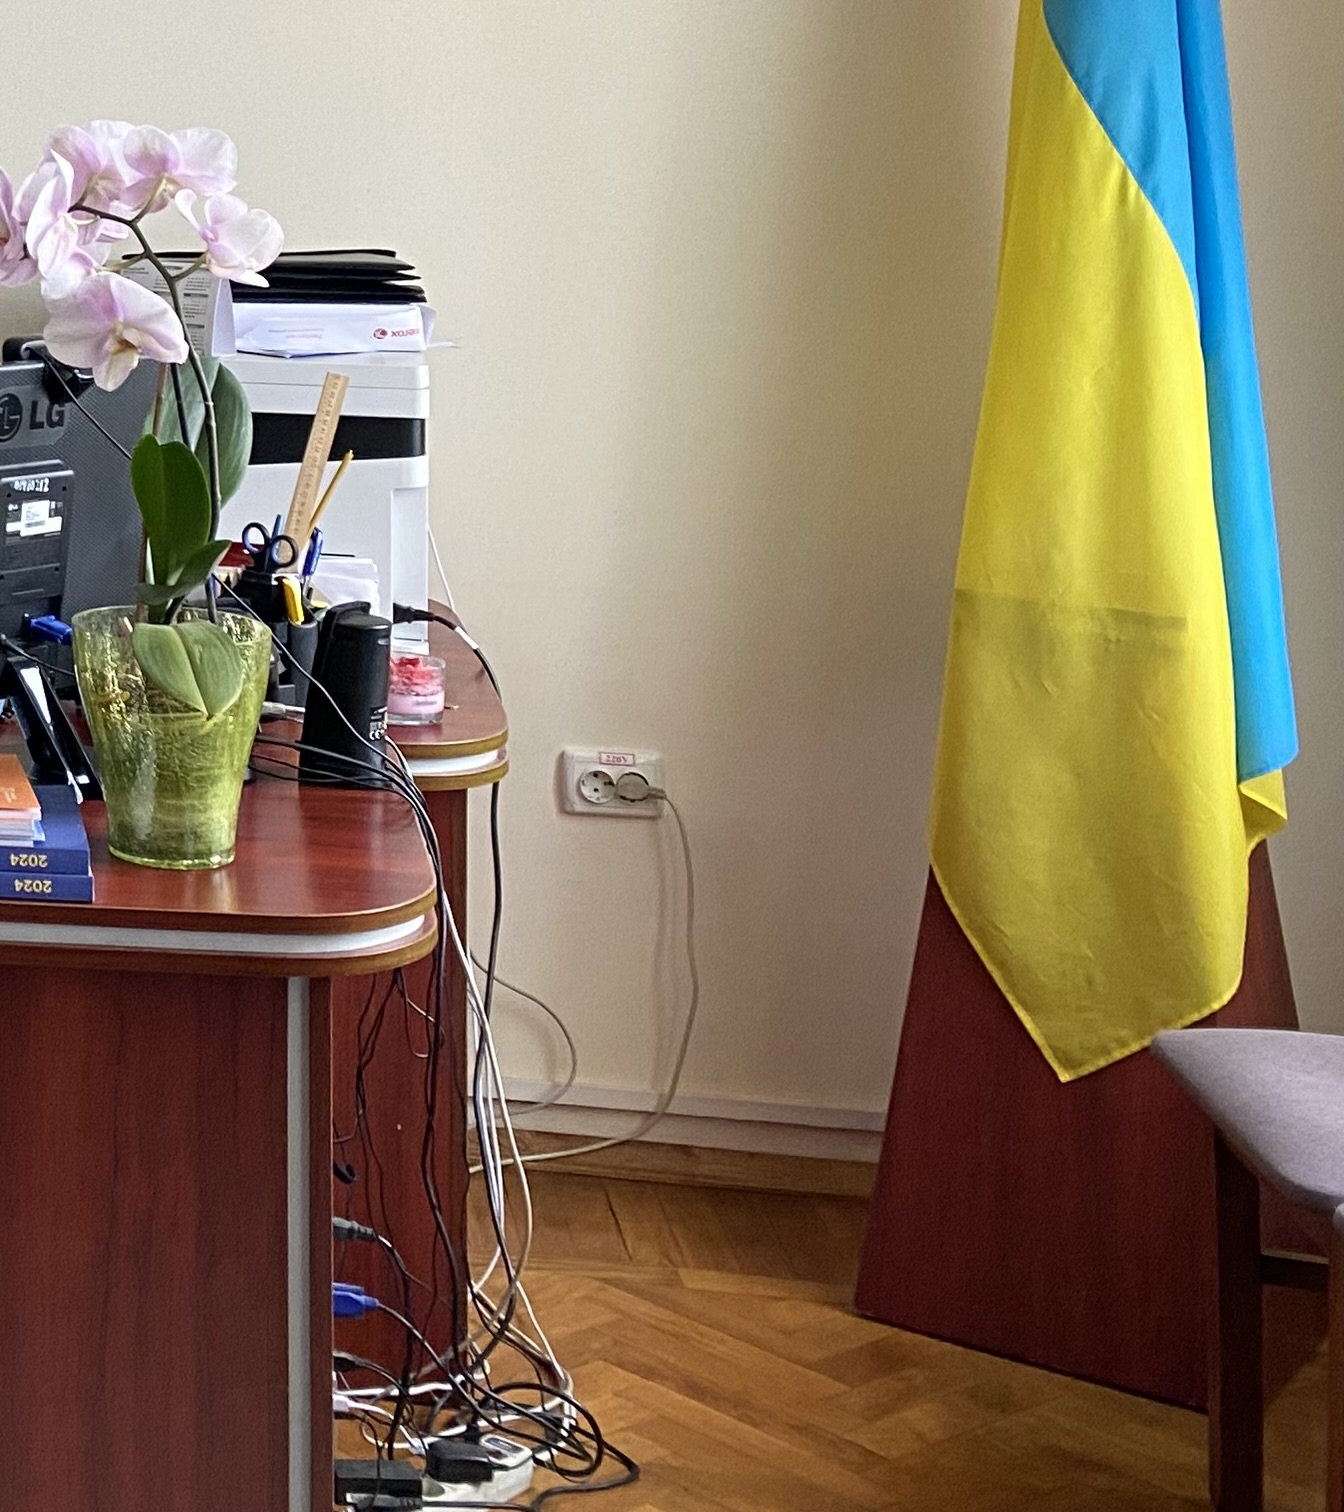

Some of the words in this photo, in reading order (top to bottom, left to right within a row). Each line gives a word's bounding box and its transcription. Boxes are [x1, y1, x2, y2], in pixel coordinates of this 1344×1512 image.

[29, 400, 65, 430] LG
[10, 852, 48, 868] 2024
[14, 878, 52, 893] 2024
